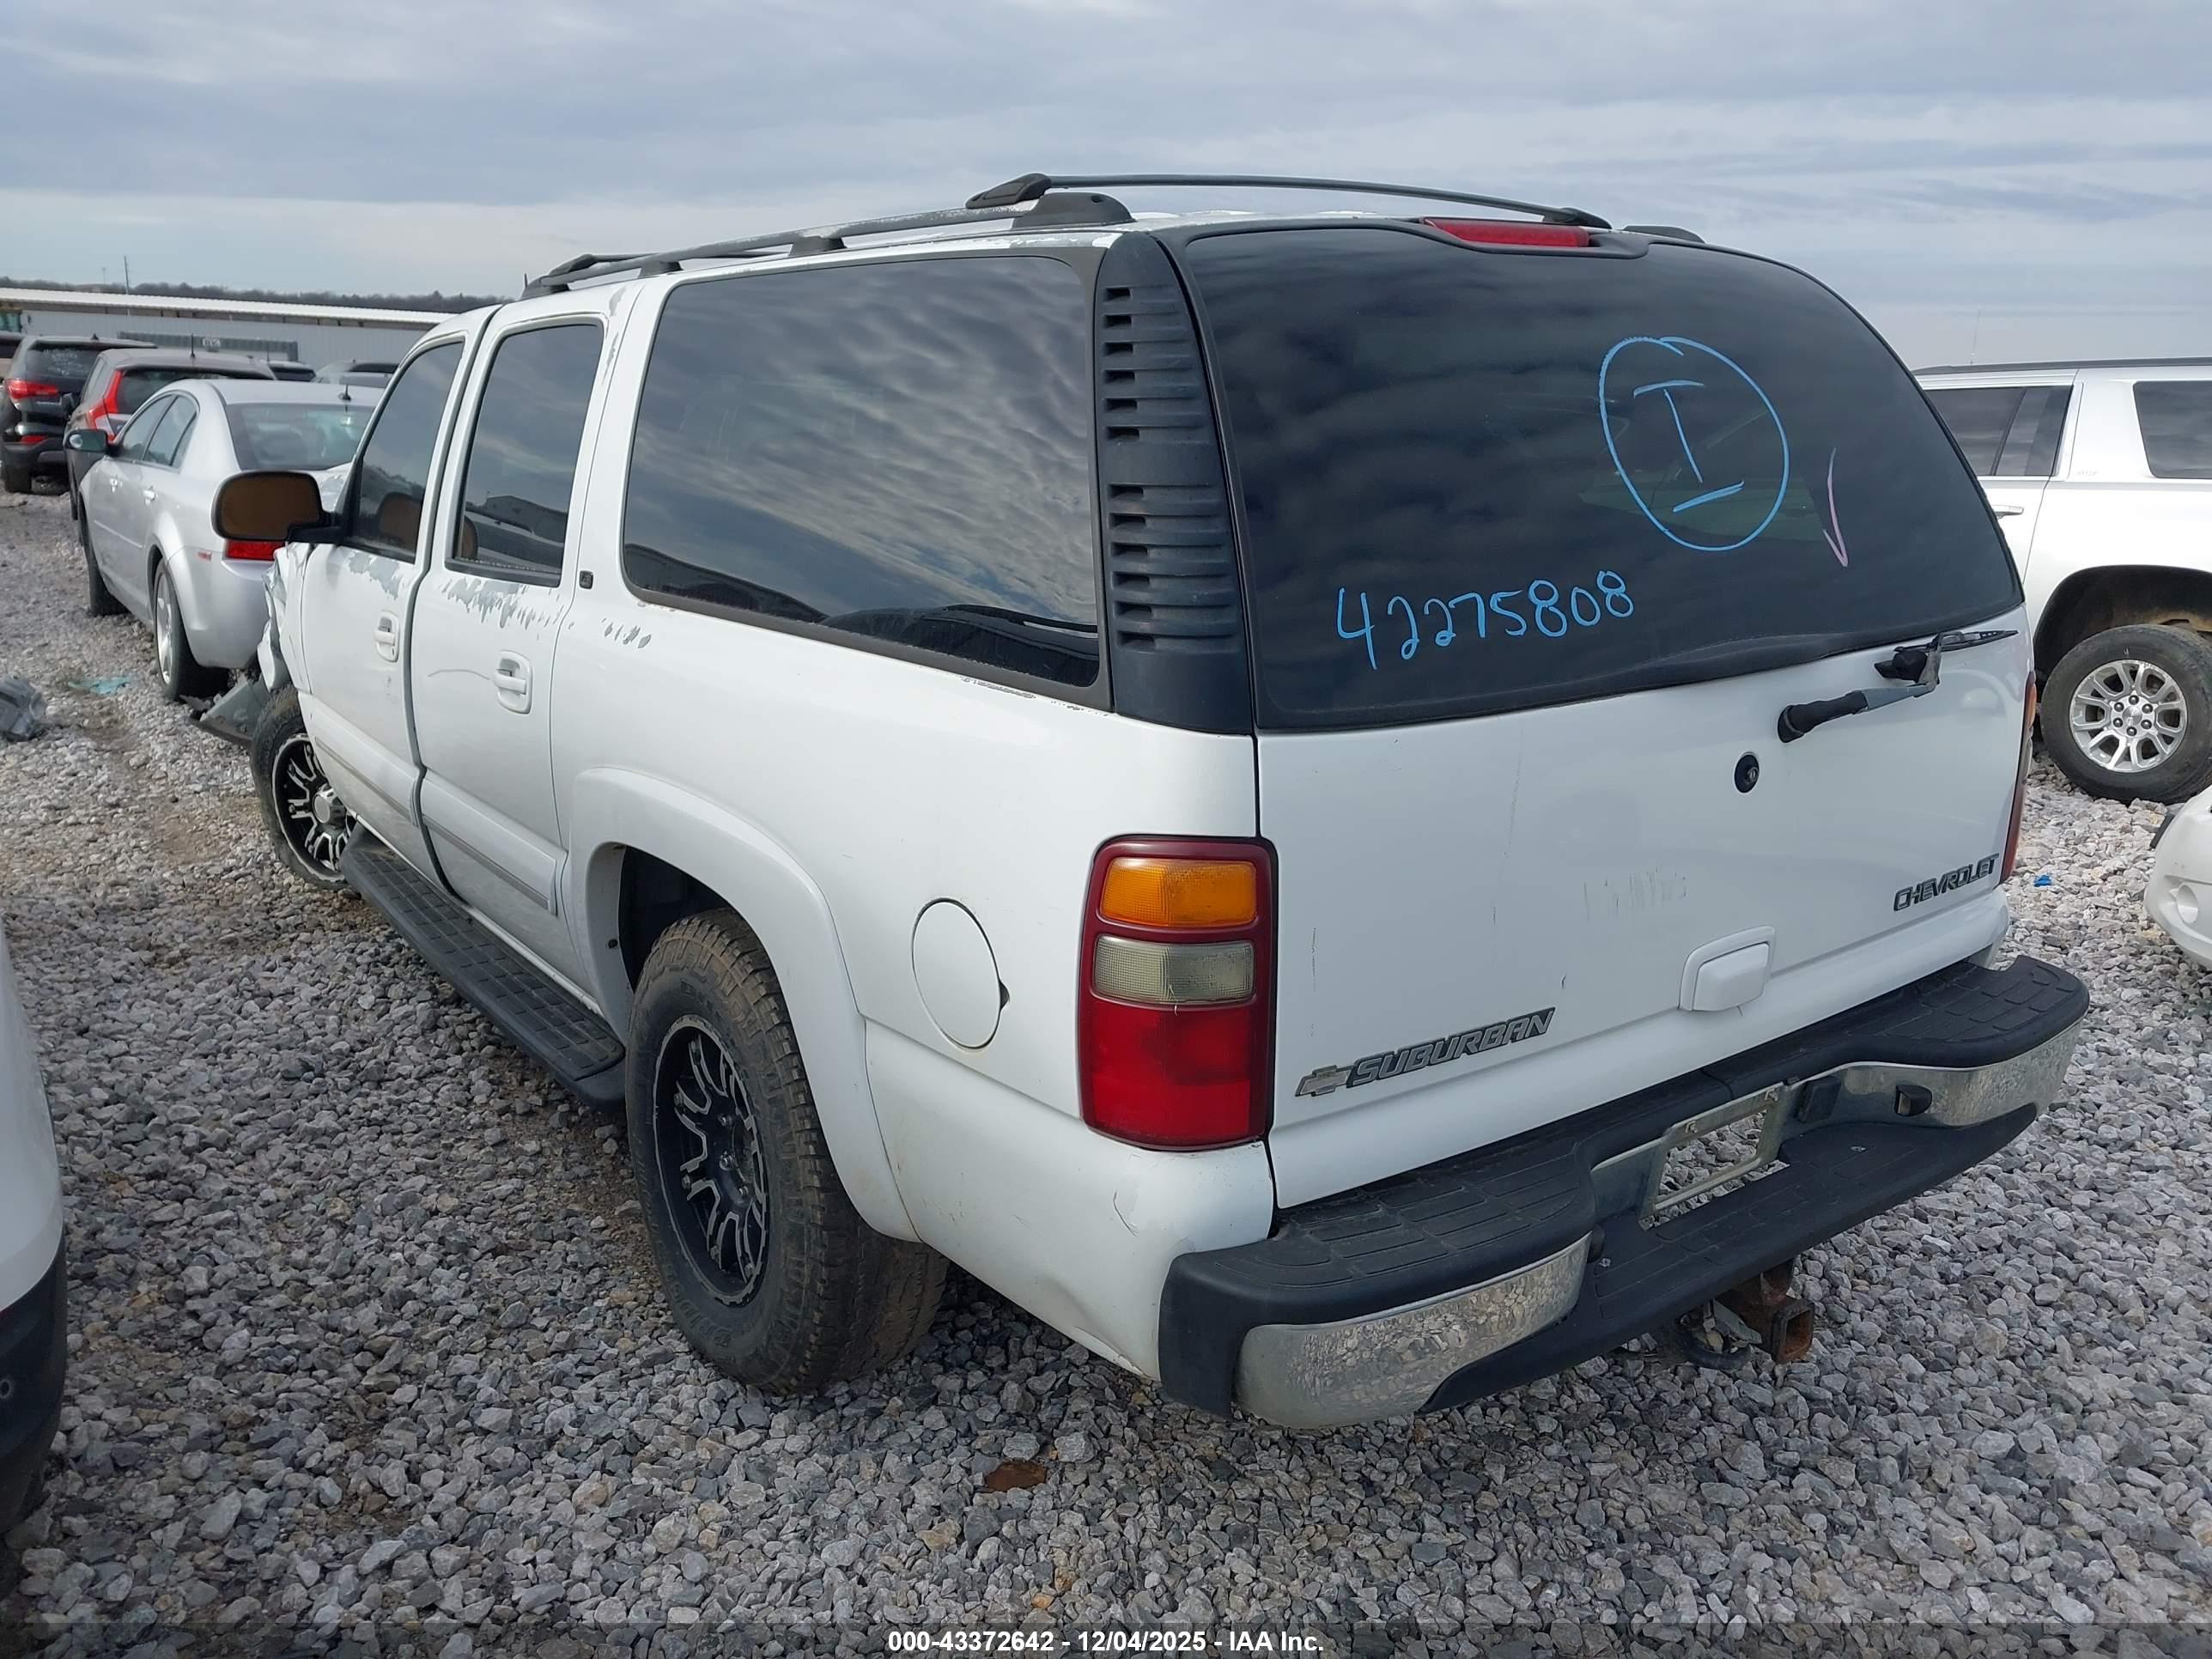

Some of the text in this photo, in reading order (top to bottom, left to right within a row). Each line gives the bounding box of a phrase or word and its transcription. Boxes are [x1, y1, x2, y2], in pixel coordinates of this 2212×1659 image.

[1336, 570, 1635, 670] 42275808
[1893, 853, 2000, 912] CHEVROLET
[1347, 1007, 1556, 1088] SUBURBAN
